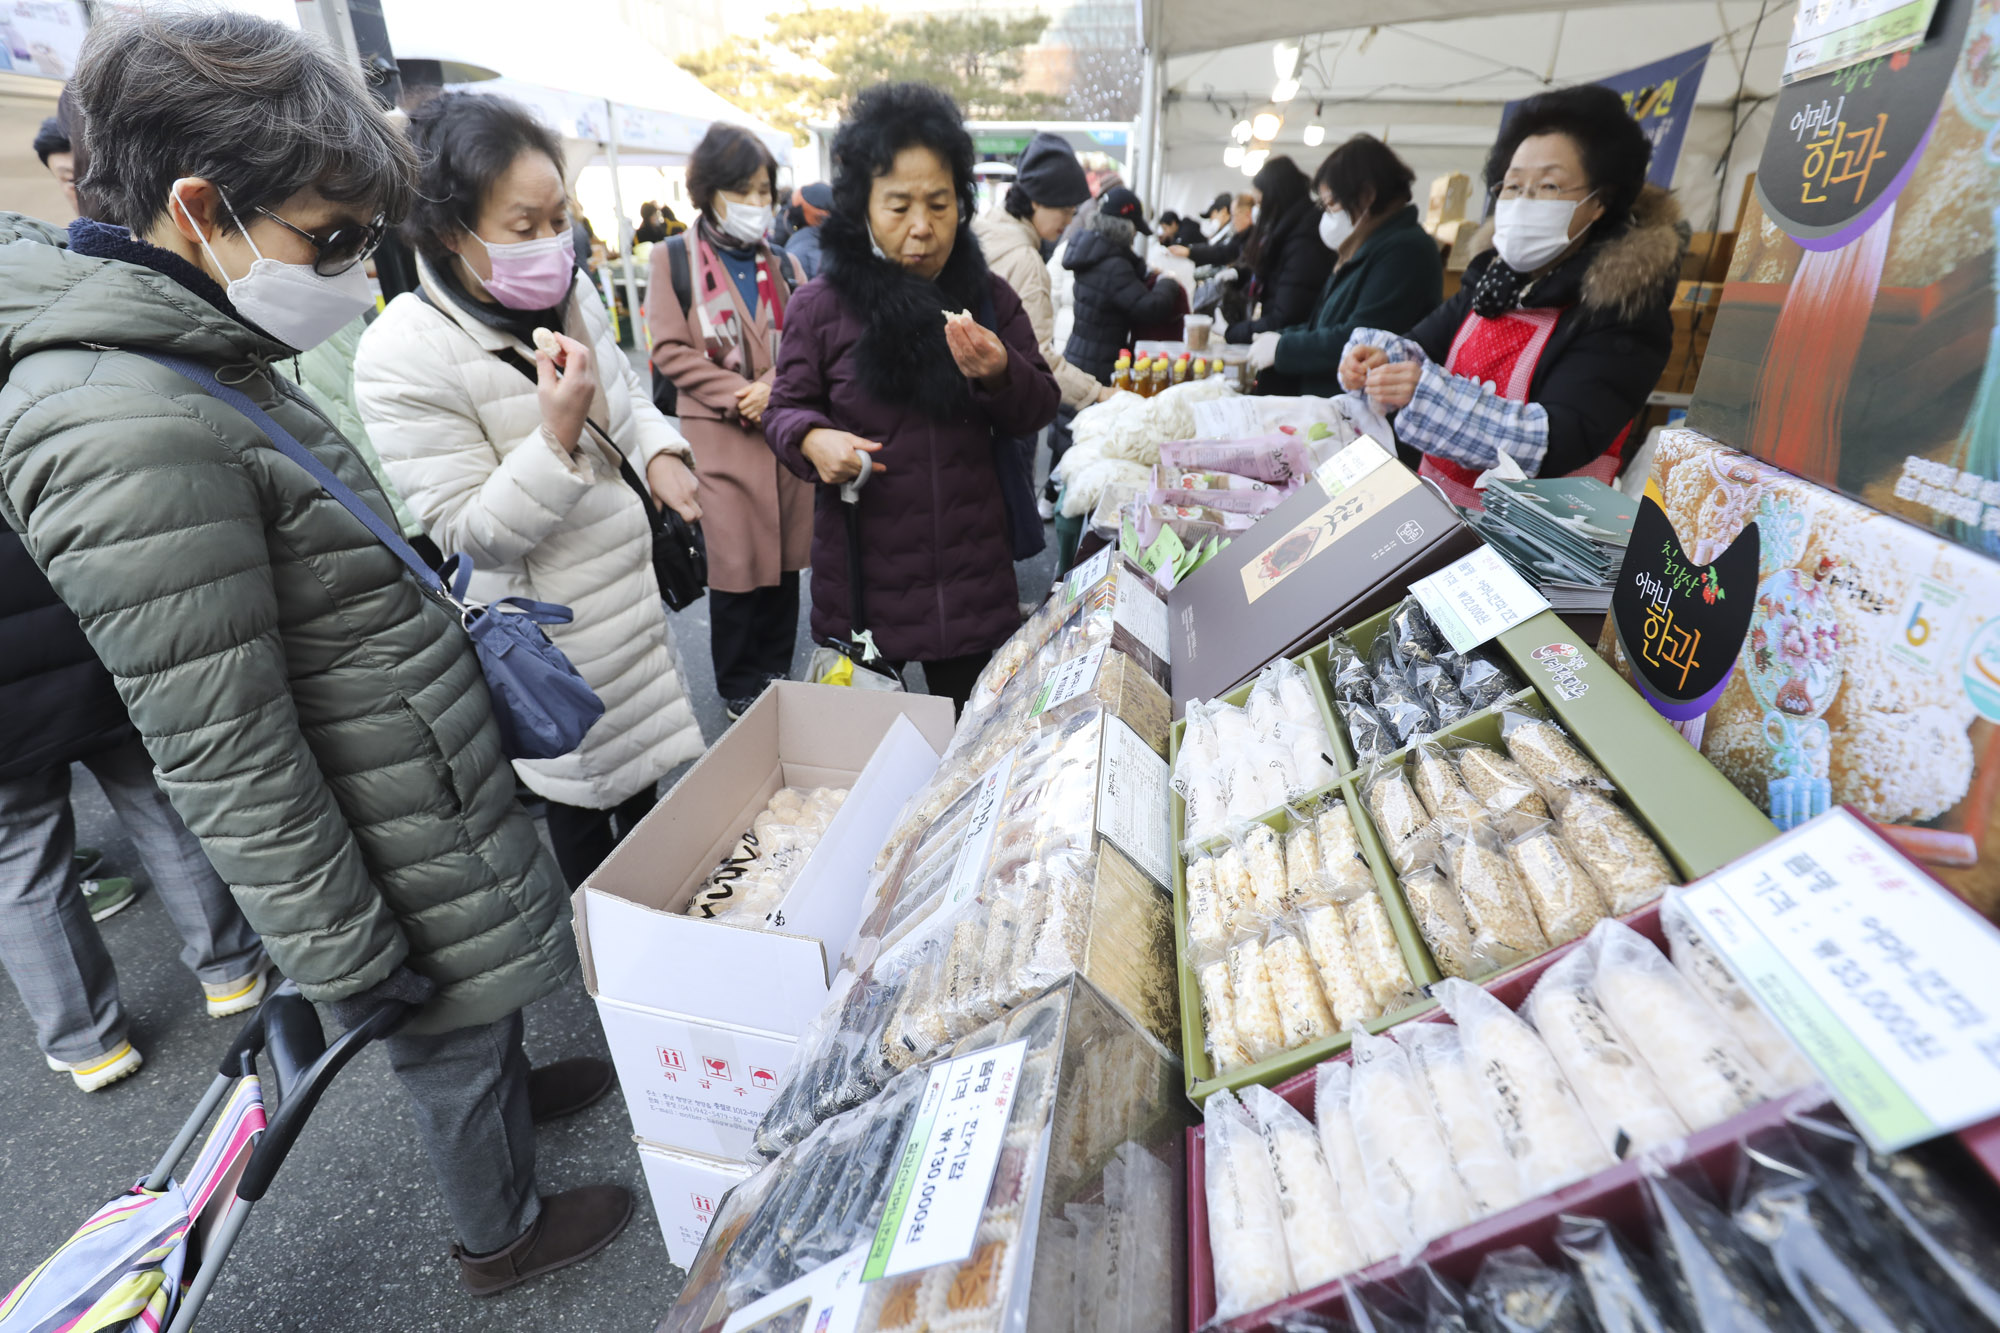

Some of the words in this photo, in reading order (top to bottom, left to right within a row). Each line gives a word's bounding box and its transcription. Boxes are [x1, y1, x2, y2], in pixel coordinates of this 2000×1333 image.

[1790, 95, 1845, 141] 어머니
[1800, 113, 1888, 204] 한과
[1442, 570, 1458, 587] 가격
[1457, 561, 1475, 576] 품명
[1476, 579, 1507, 611] 어머니한과
[1661, 540, 1700, 598] 칠갑산
[1636, 571, 1673, 616] 어머니
[1643, 603, 1701, 691] 한과
[1754, 871, 1798, 915] 가격
[1784, 852, 1837, 892] 품명
[950, 1064, 973, 1101] 가격
[974, 1059, 995, 1092] 품명
[948, 1118, 978, 1180] 한지함
[906, 1127, 953, 1242] ₩130,000원
